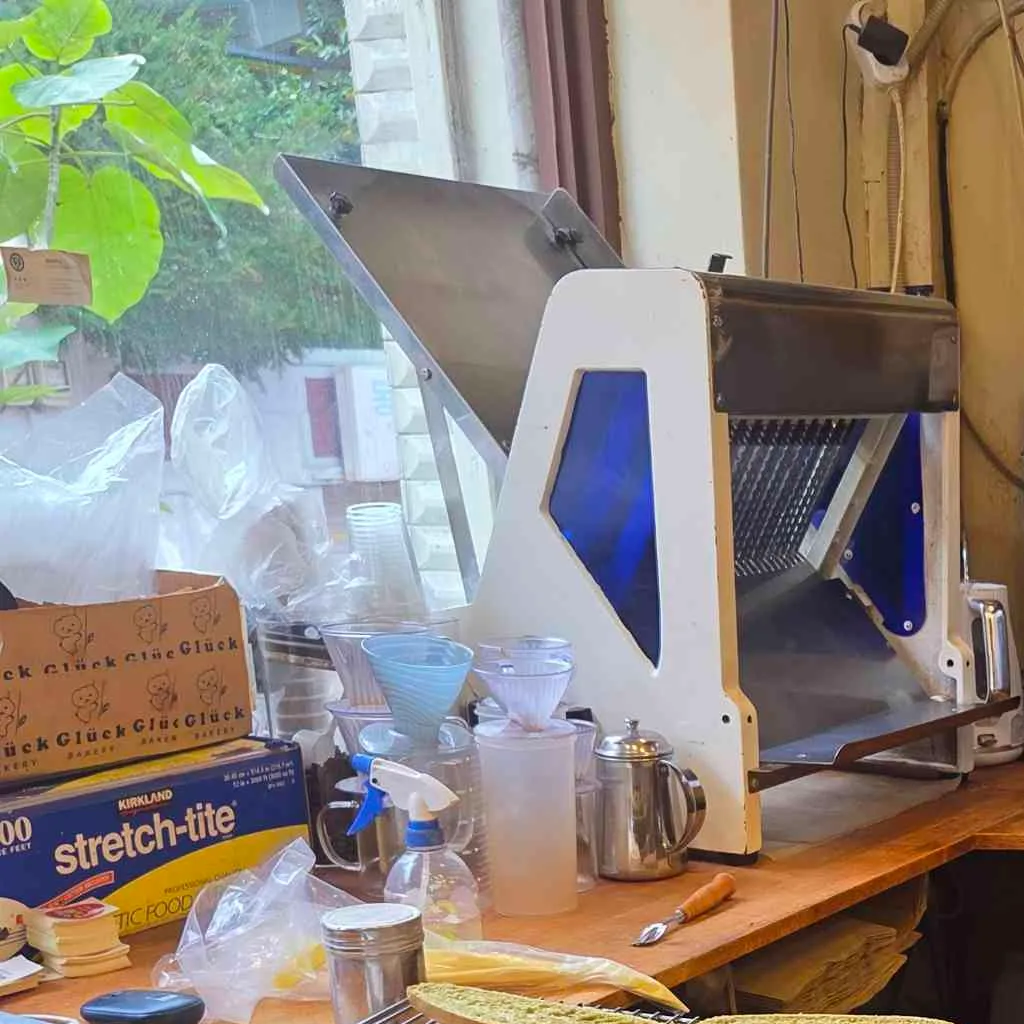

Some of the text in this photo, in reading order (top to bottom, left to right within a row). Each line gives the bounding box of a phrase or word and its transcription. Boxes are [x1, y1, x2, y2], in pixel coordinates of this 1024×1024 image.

[179, 637, 238, 656] Glück
[56, 724, 126, 747] Glück
[184, 707, 246, 728] Glück
[118, 789, 173, 811] KIRKLAND
[54, 802, 236, 875] stretch-tite
[145, 894, 194, 921] FOOD
